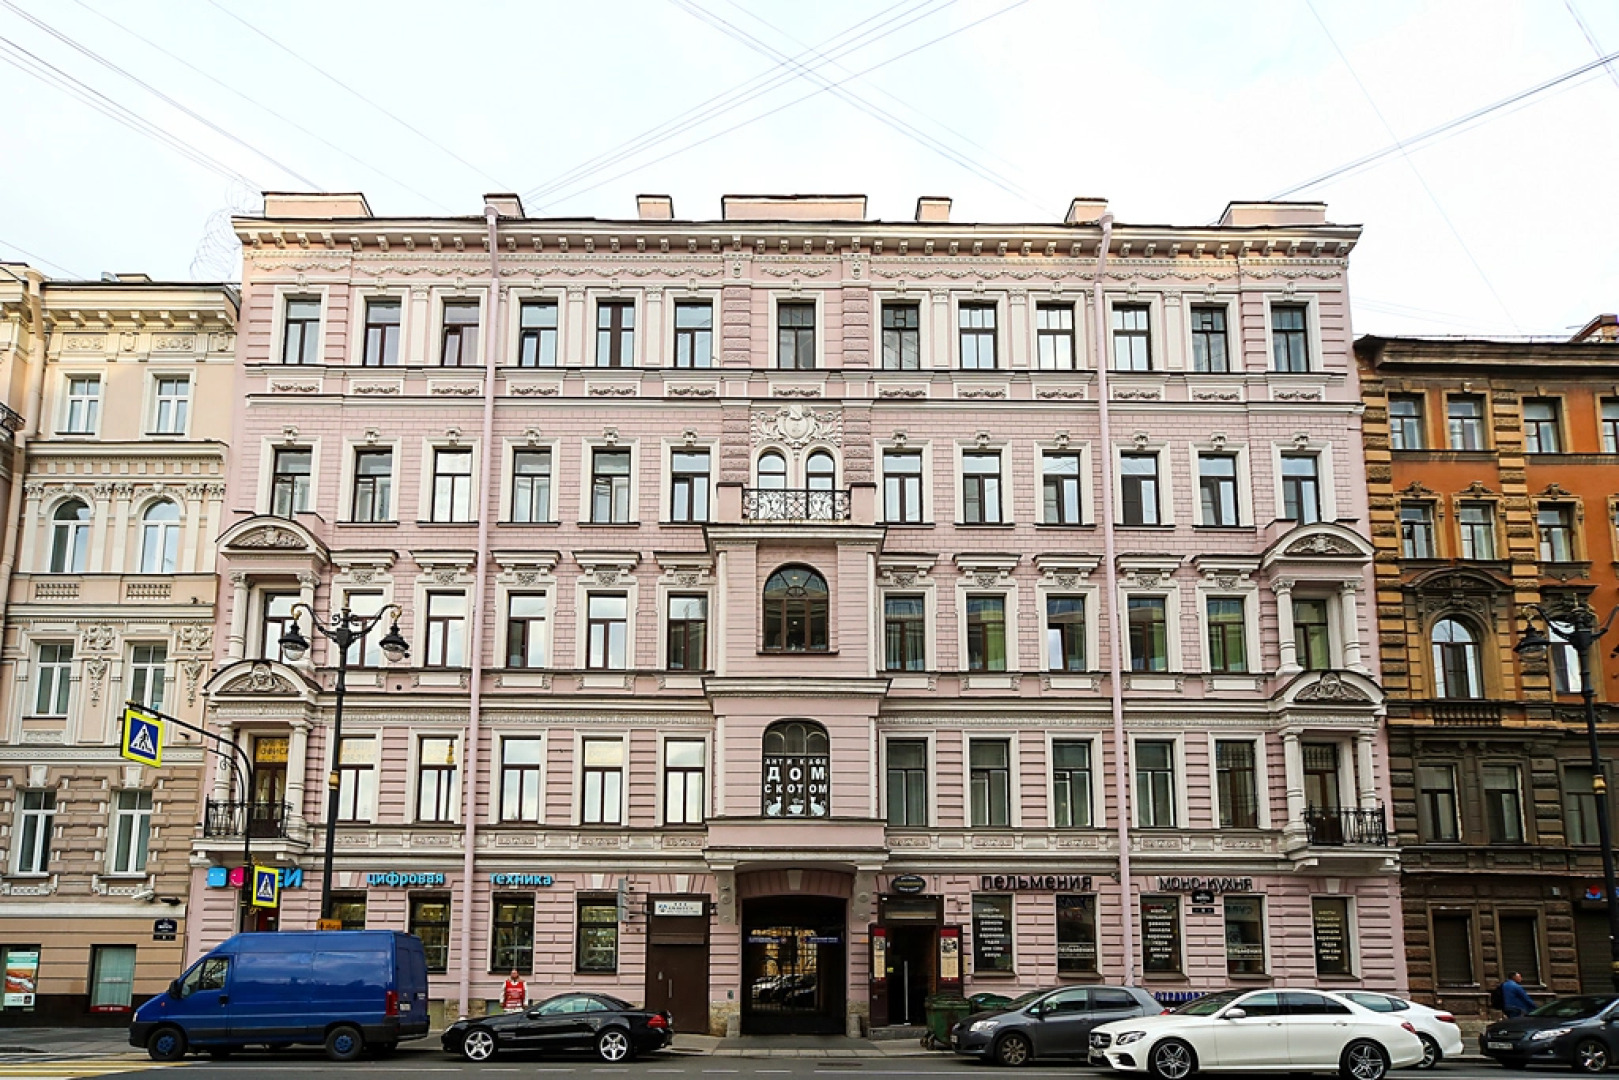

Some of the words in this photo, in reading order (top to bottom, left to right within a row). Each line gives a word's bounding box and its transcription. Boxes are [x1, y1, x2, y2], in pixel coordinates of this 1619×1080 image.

[767, 766, 825, 782] ДОМ
[366, 870, 445, 888] цифровая
[489, 872, 552, 886] техника
